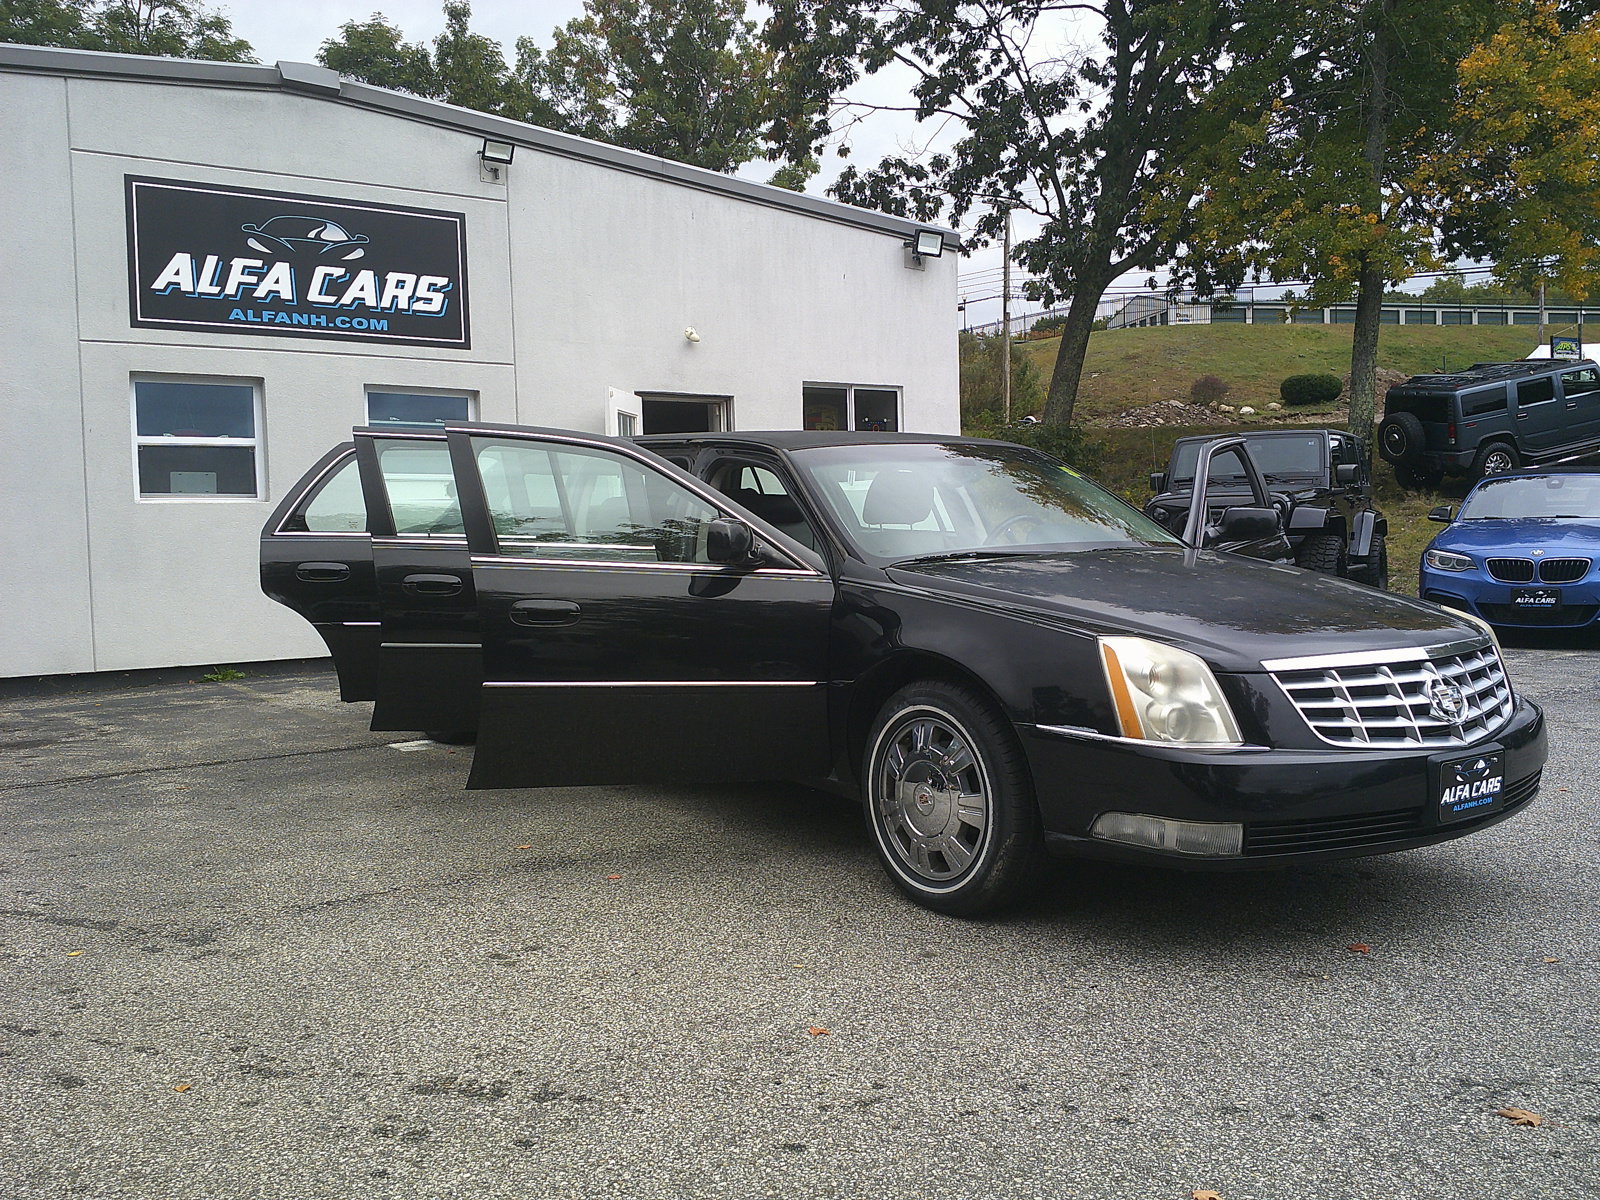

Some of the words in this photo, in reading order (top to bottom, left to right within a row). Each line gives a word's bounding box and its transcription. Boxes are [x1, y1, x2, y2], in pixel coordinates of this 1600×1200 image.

[151, 252, 296, 304] ALFA
[306, 265, 452, 316] CARS
[229, 308, 388, 331] ALFANH.COM
[1441, 783, 1470, 805] ALFA
[1471, 776, 1503, 798] CARS
[1452, 797, 1493, 812] ALFANH.COM
